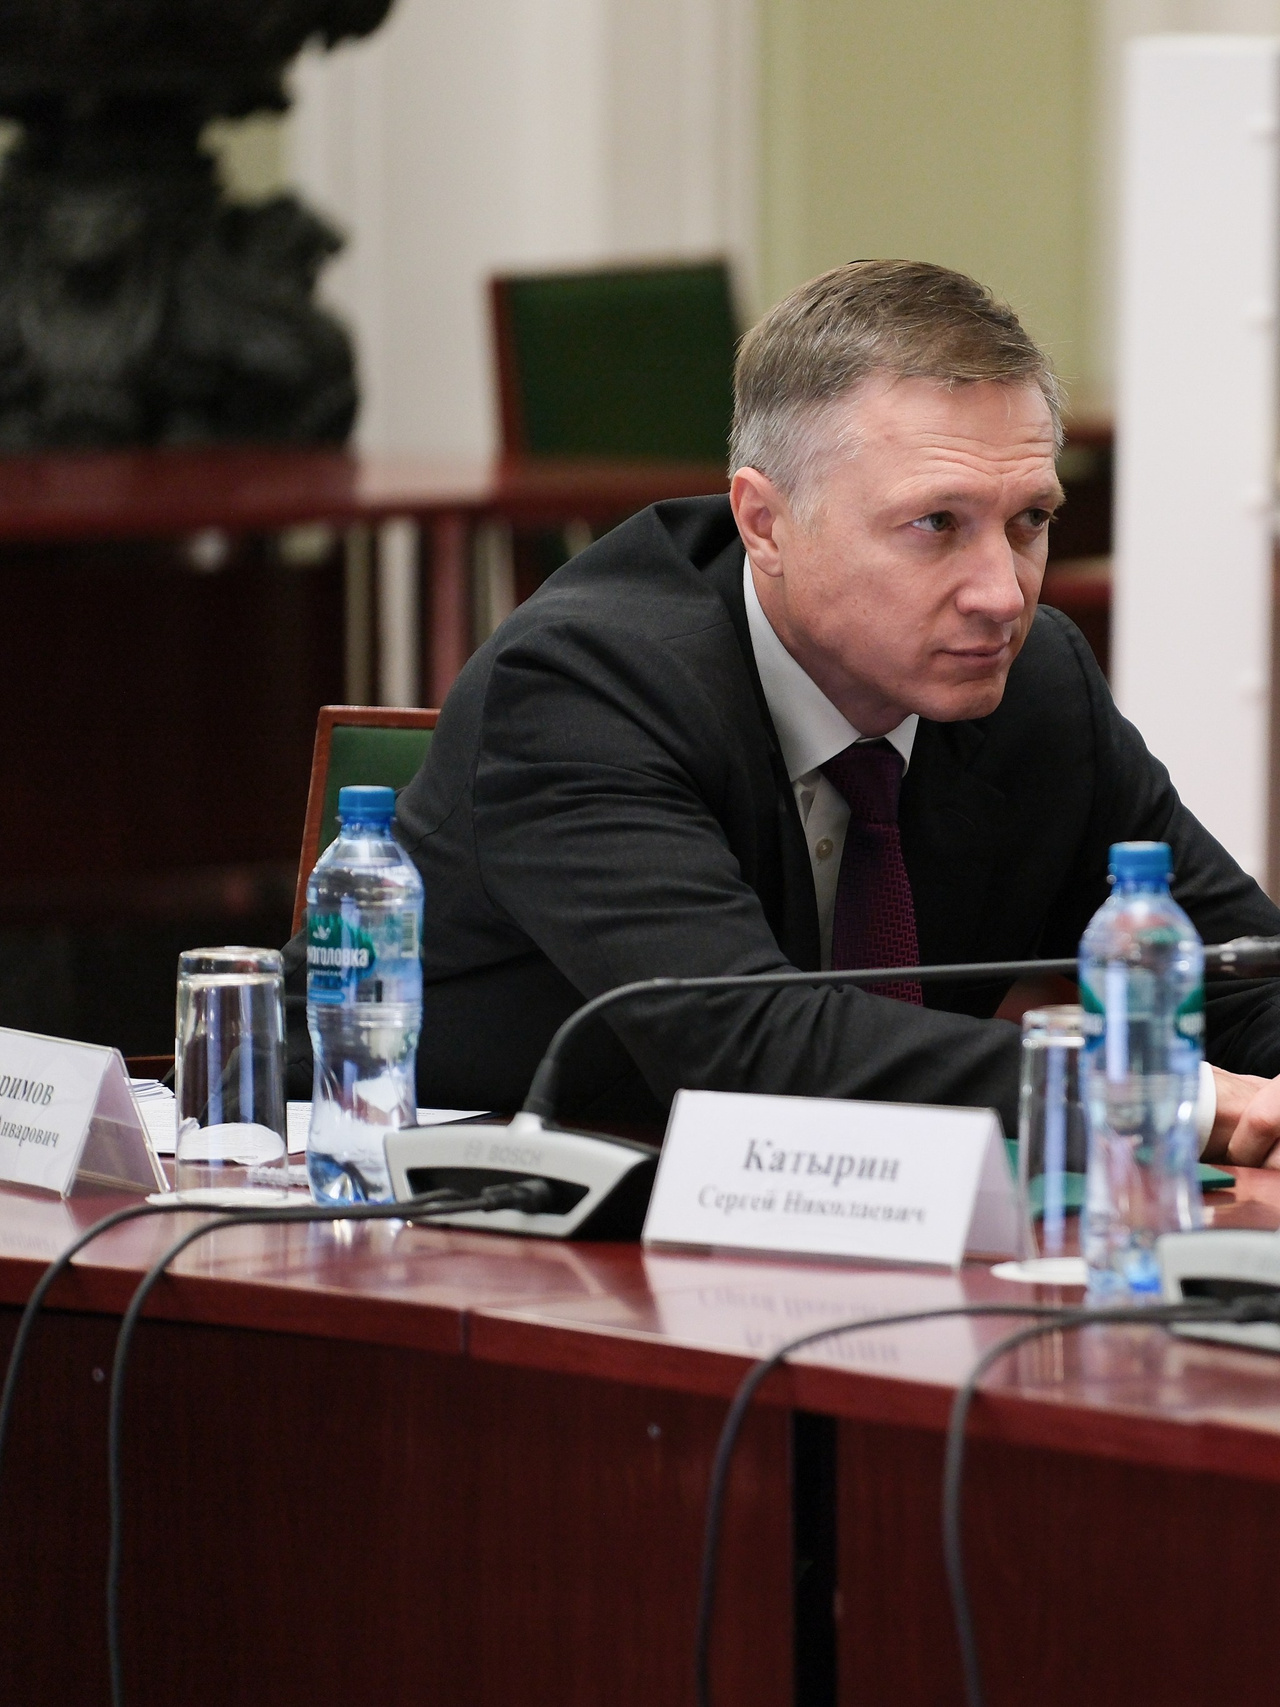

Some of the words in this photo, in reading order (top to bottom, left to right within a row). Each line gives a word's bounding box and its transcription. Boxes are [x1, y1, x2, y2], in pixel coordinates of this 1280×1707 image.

[0, 1116, 60, 1148] нварович
[743, 1138, 901, 1188] Катырин
[698, 1184, 777, 1216] Сергей
[783, 1189, 926, 1224] Николаевич
